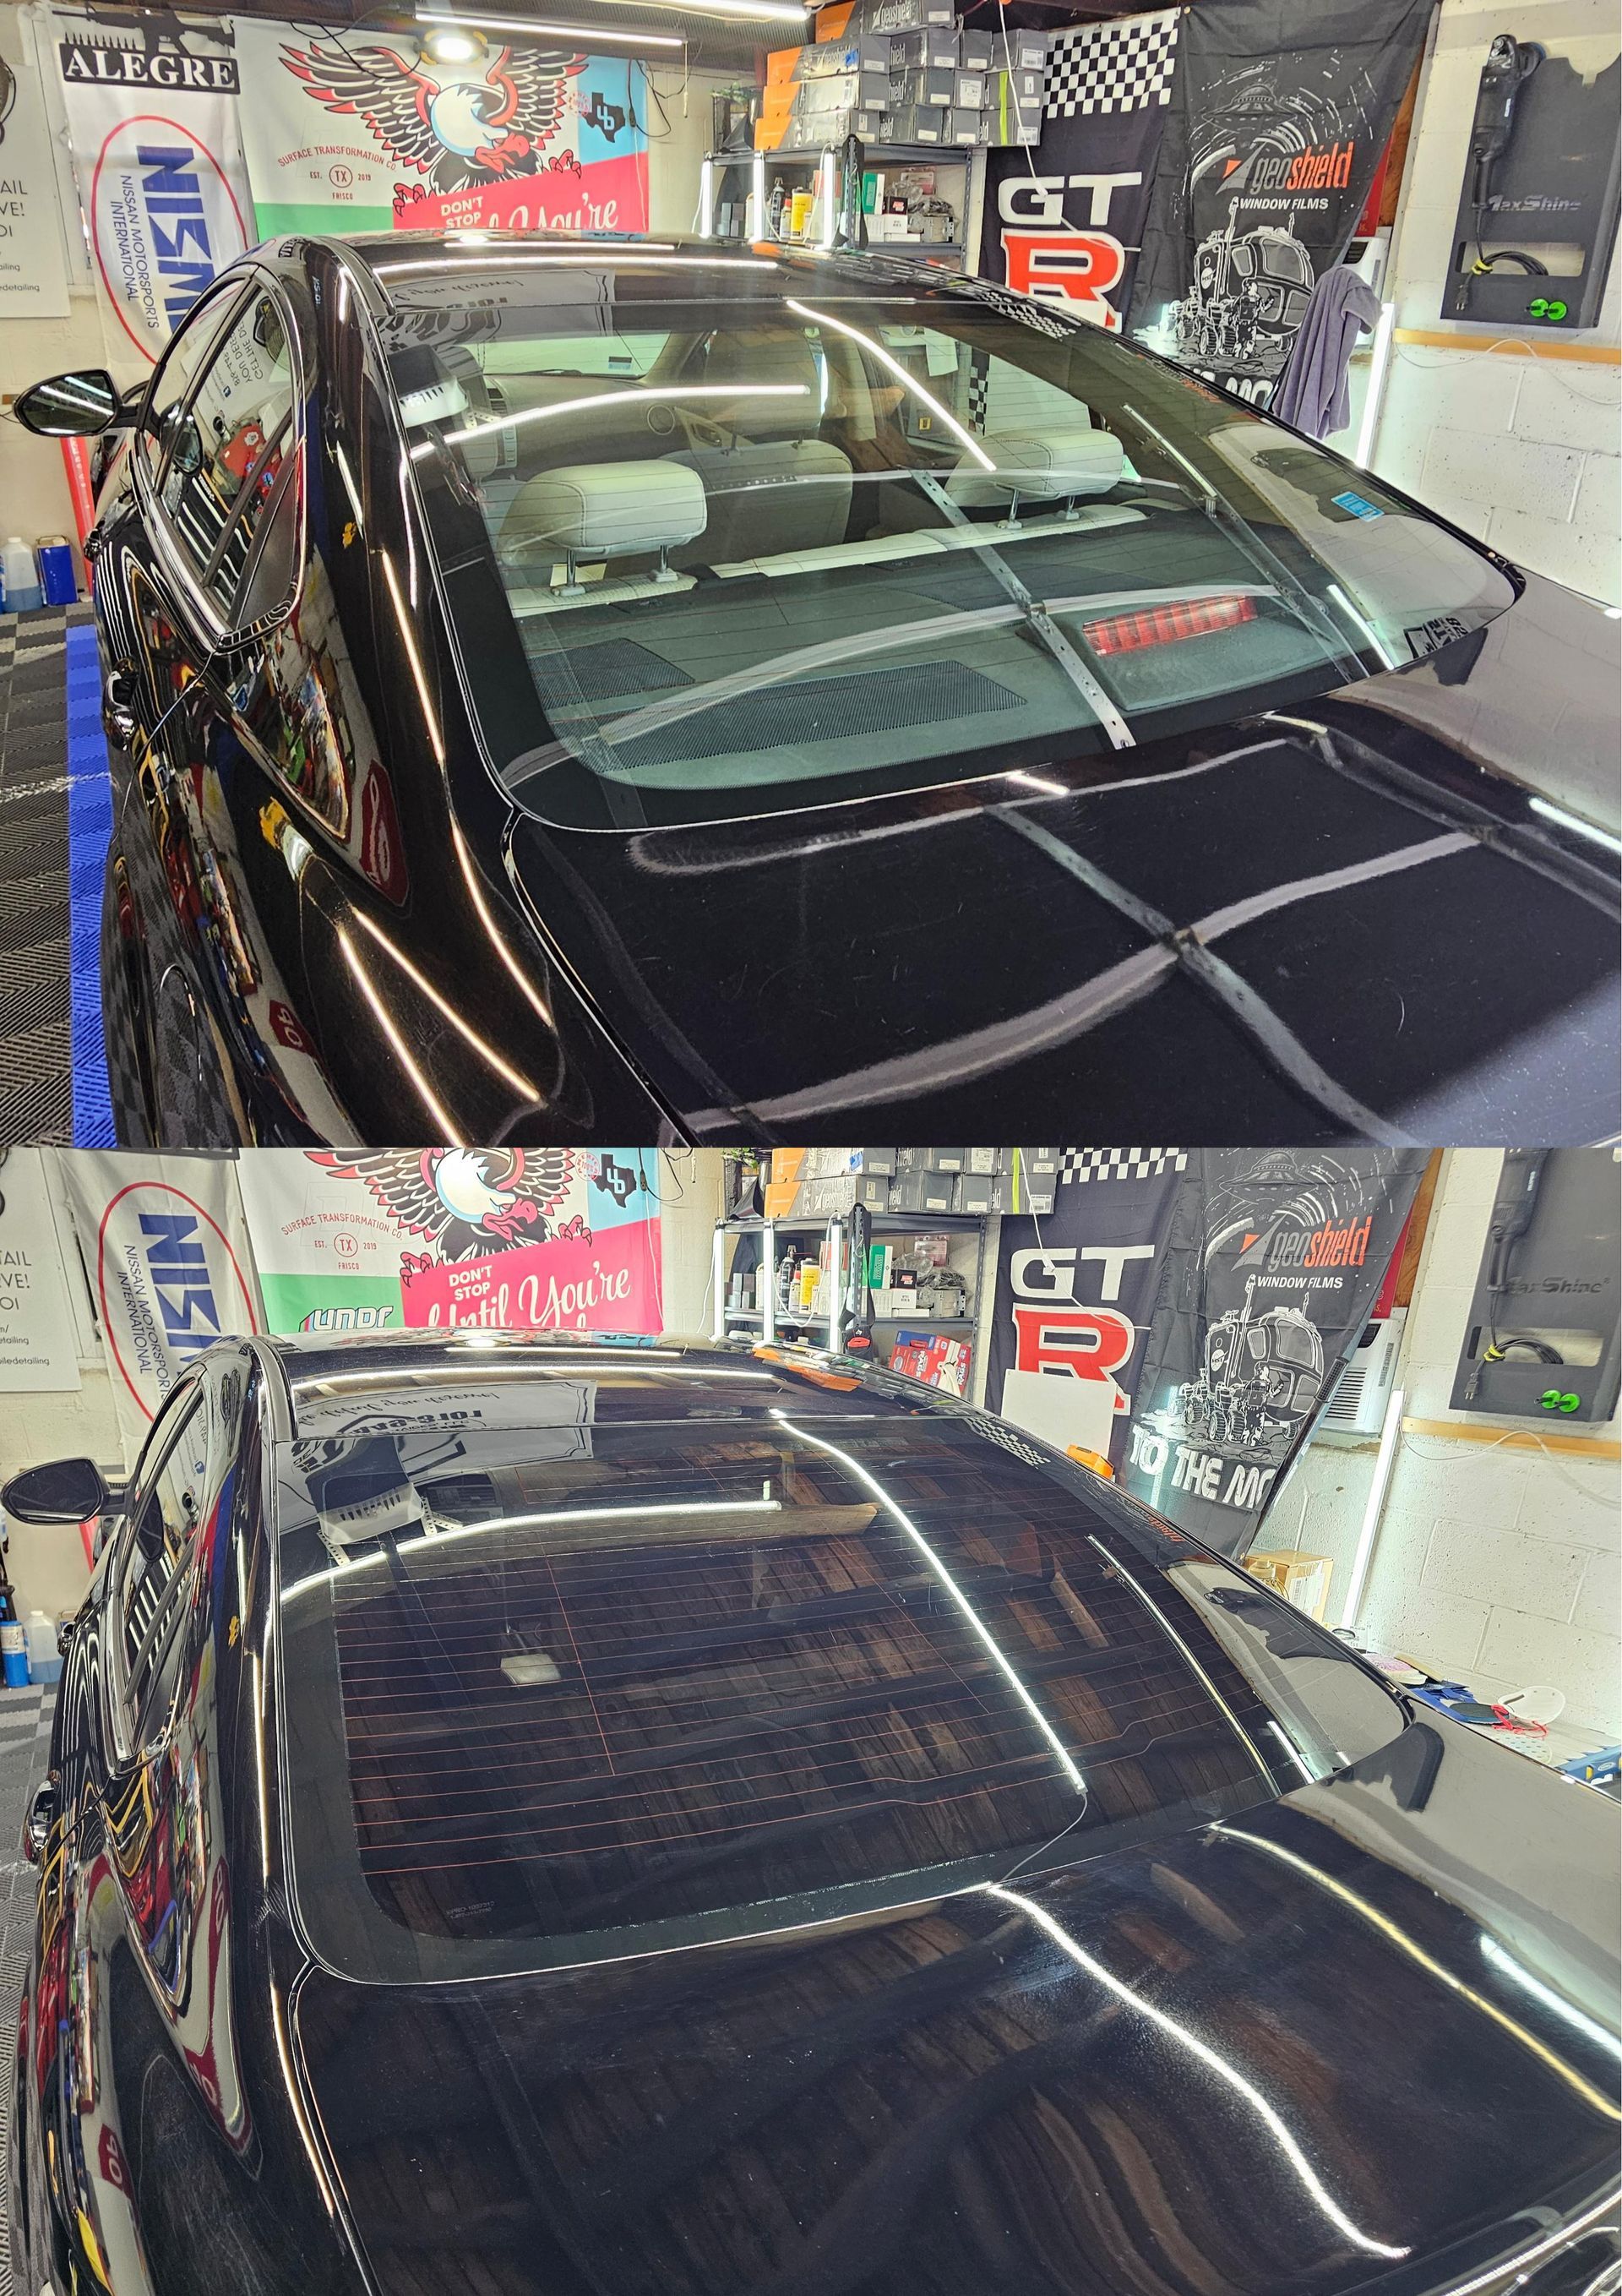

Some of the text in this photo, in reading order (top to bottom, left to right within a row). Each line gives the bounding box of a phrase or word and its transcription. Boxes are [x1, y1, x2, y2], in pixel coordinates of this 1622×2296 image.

[65, 48, 237, 89] ALEGRE
[278, 148, 313, 167] SURFACE
[314, 145, 384, 165] TRANSFORMATION
[309, 171, 371, 183] EST. TX 2019
[1250, 142, 1354, 194] geoshield
[440, 196, 483, 216] DON'T
[446, 212, 482, 228] STOP
[999, 172, 1142, 226] GT
[1239, 198, 1329, 210] WINDOW FILMS
[111, 201, 139, 300] INTERNATIONAL
[120, 175, 159, 329] NISSAN MOTORSPORTS
[1001, 227, 1125, 333] R
[281, 1215, 317, 1235] SURFACE
[318, 1213, 389, 1233] TRANSFORMATION
[340, 1239, 352, 1252] TX
[1268, 1215, 1373, 1271] geoshield
[449, 1266, 493, 1286] DON'T
[454, 1283, 490, 1301] STOP
[518, 1261, 631, 1327] You're
[1010, 1245, 1155, 1301] GT
[1257, 1277, 1343, 1290] WINDOW FILMS
[117, 1272, 152, 1374] INTERNATIONAL
[124, 1246, 171, 1400] NISSAN MOTORSPOR
[1011, 1302, 1135, 1416] R
[1129, 1424, 1170, 1475] TO
[1171, 1446, 1222, 1497] THE
